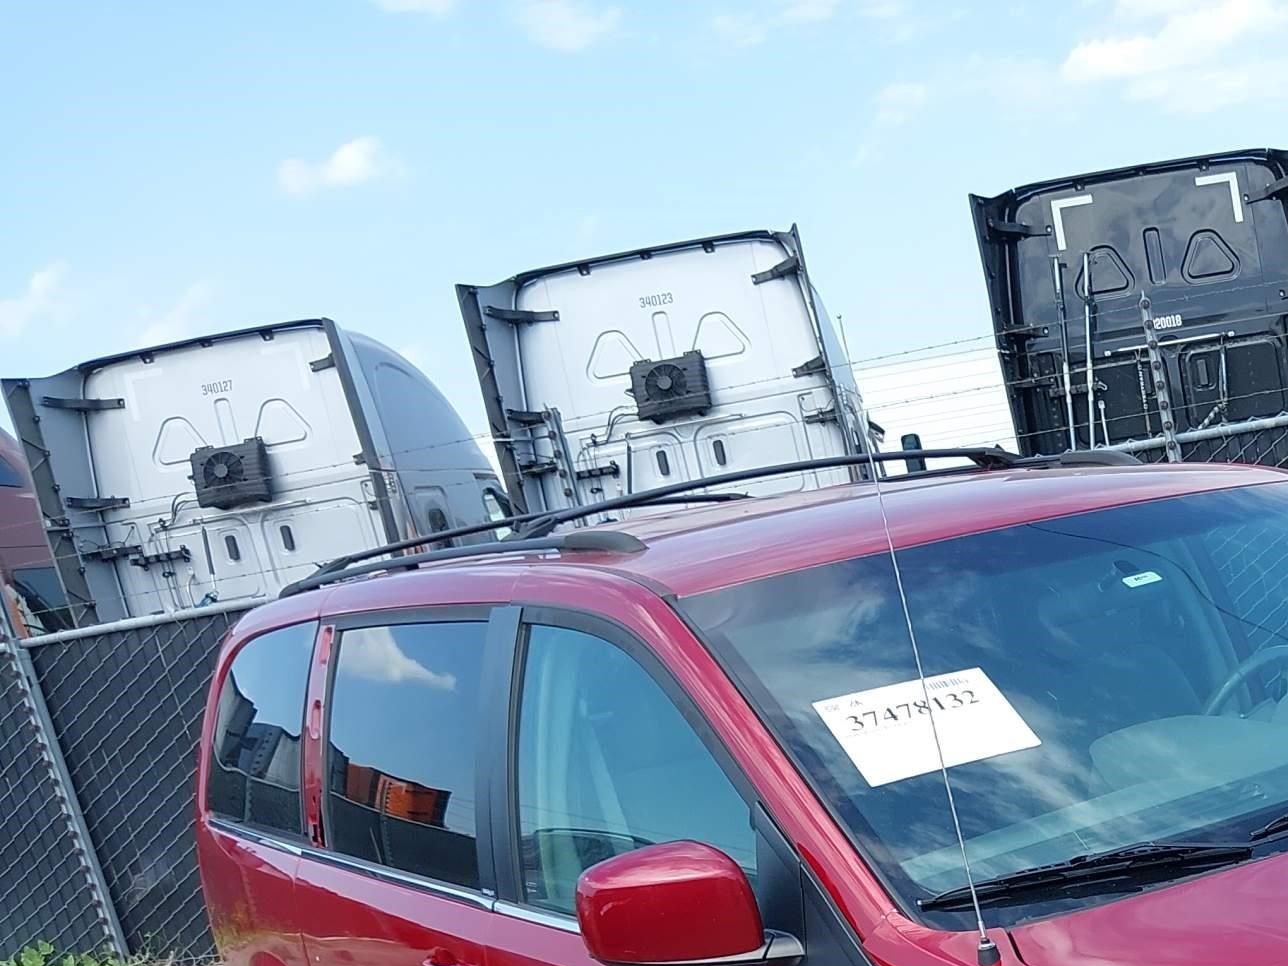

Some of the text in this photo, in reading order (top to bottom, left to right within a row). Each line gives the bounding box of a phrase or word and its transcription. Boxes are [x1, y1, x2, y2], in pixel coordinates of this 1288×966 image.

[639, 291, 674, 309] 340123
[1152, 314, 1183, 330] 20018
[201, 379, 233, 396] 340127
[846, 689, 981, 732] 37478132
